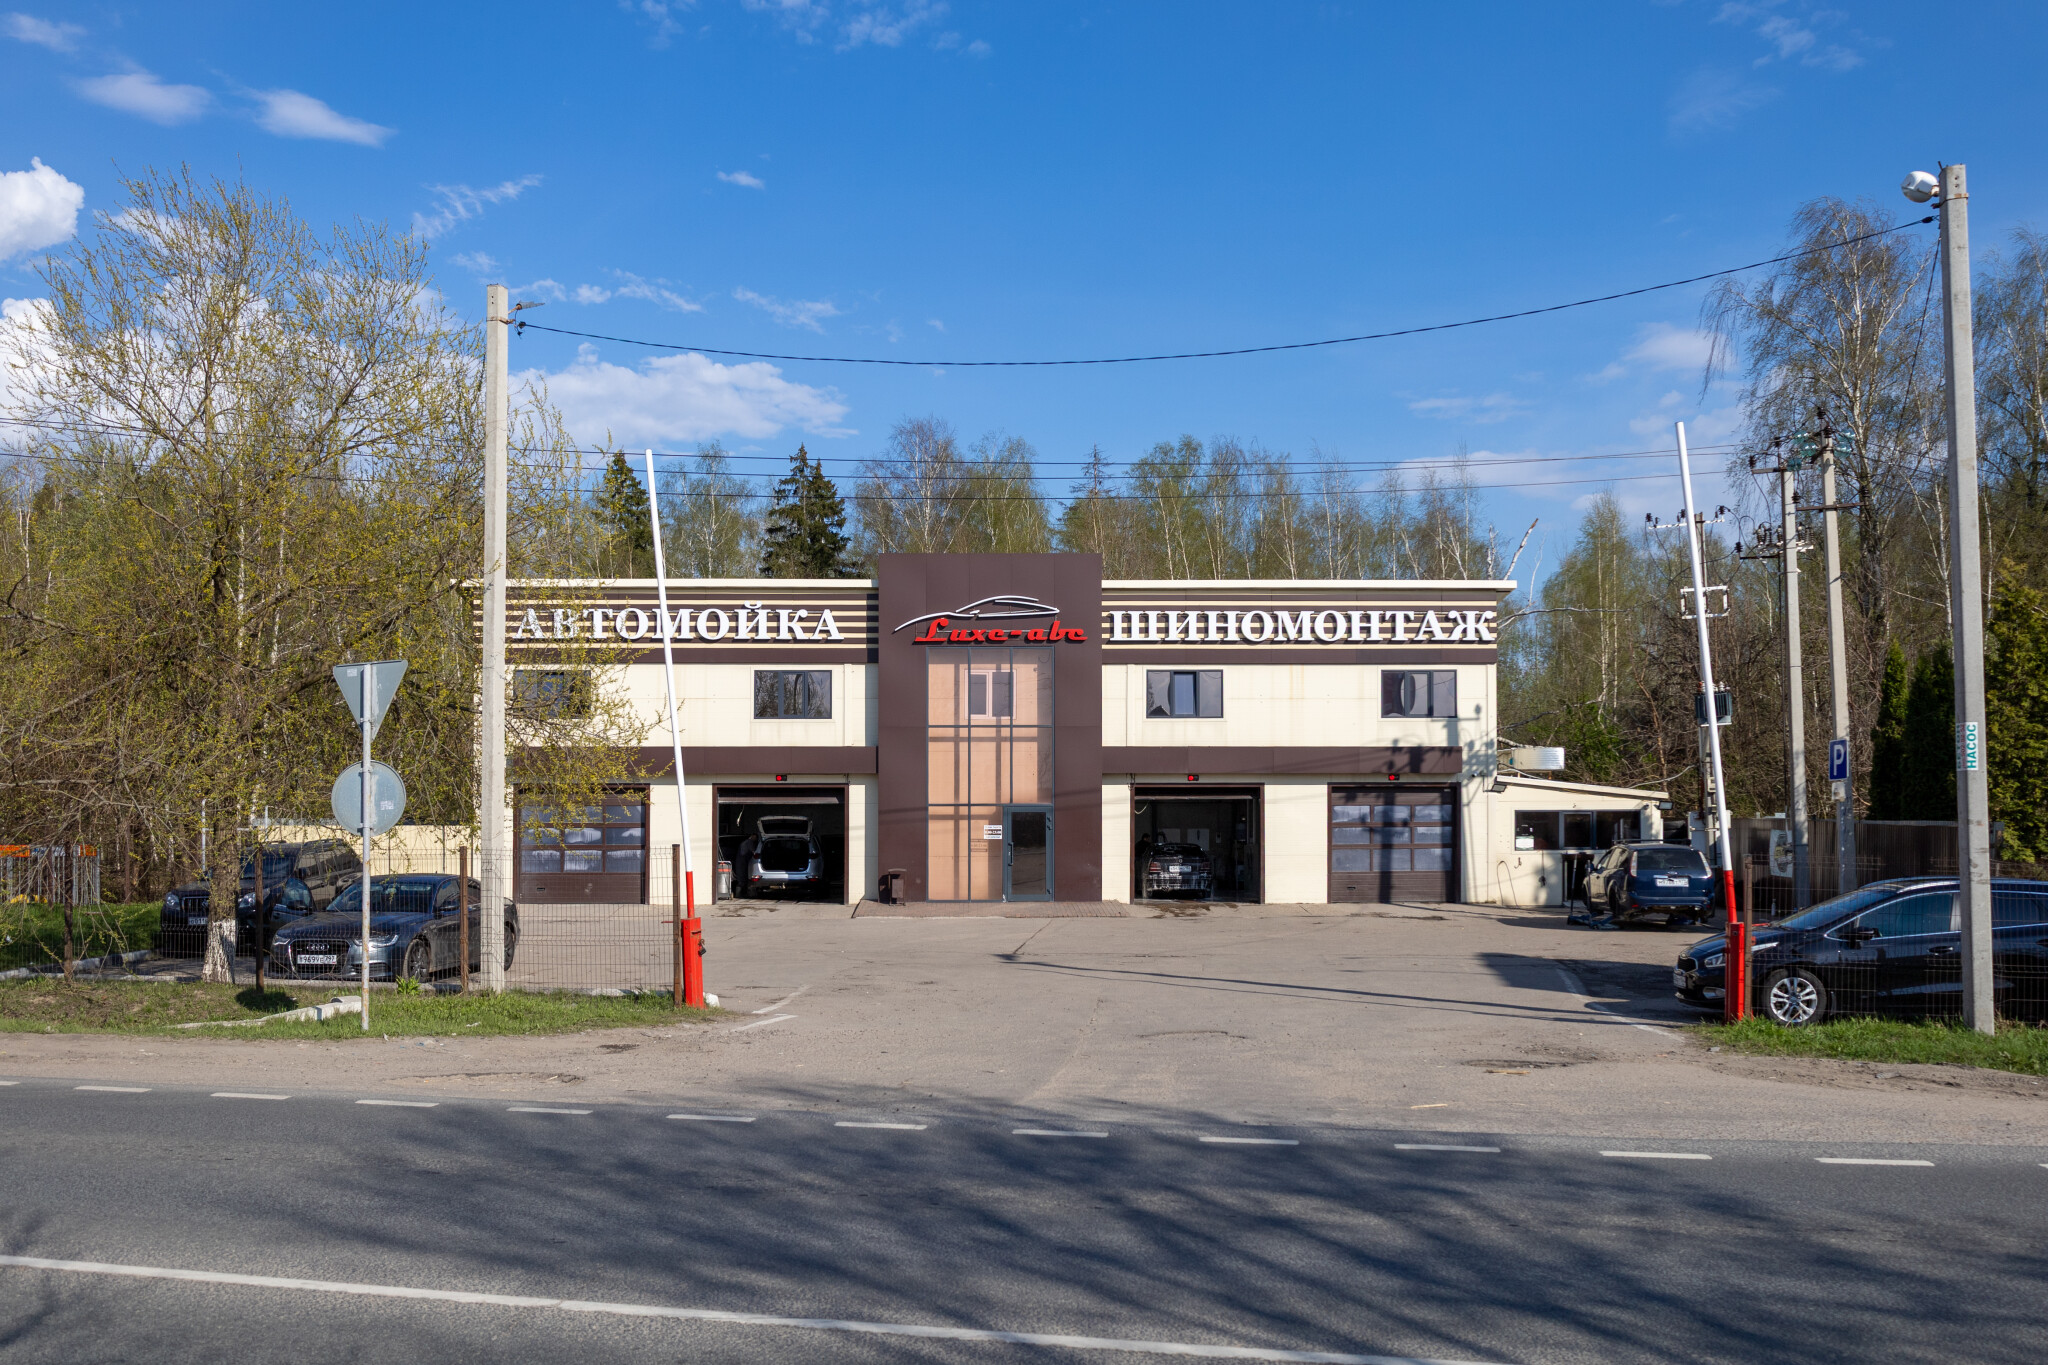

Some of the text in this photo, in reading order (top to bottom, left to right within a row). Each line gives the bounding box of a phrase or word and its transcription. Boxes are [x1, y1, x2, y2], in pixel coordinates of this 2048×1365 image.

[512, 600, 845, 640] АВТОМОЙКА
[1107, 609, 1495, 642] ШИНОМОНТАЖ
[1966, 724, 1977, 769] НАСОС
